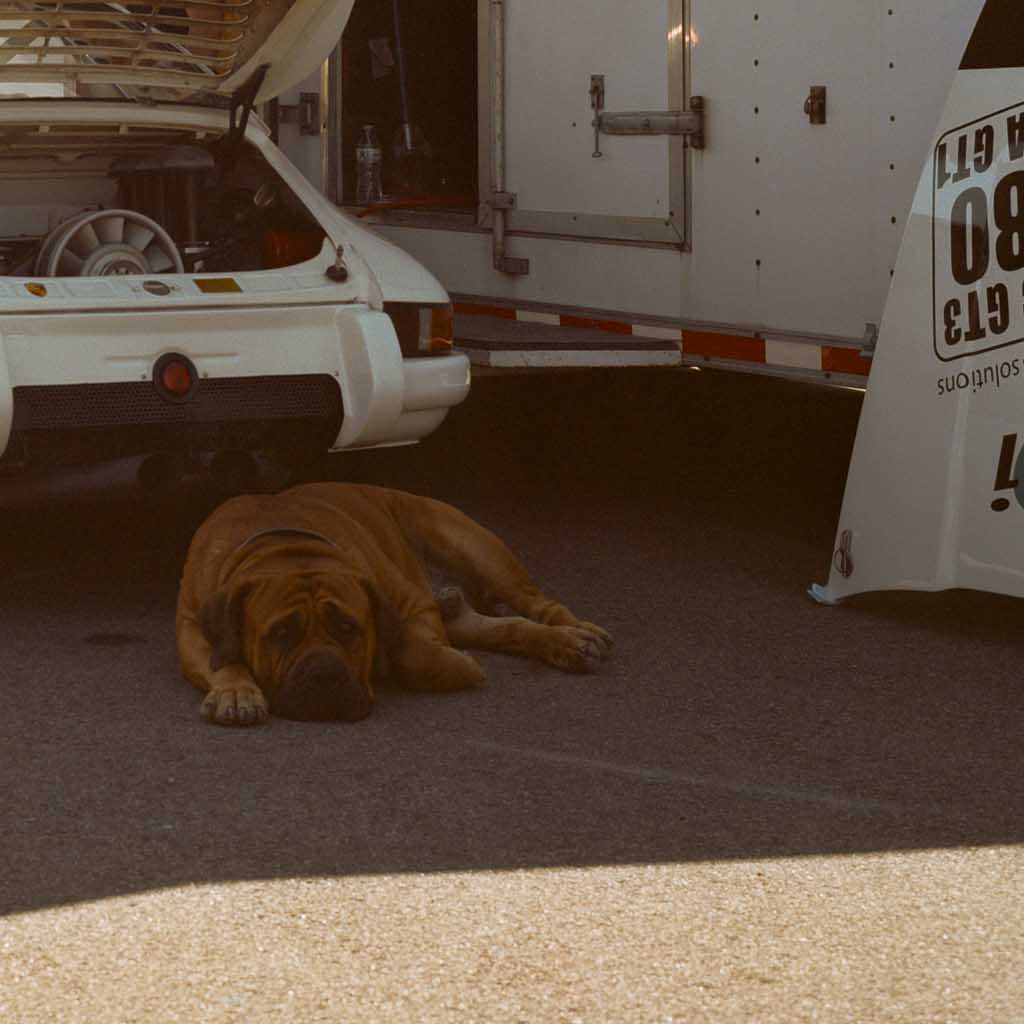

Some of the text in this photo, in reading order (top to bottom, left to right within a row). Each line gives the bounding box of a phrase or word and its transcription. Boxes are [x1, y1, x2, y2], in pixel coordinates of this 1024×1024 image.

[936, 124, 995, 190] GT1
[943, 282, 1010, 346] GT3
[937, 359, 1020, 395] solutions
